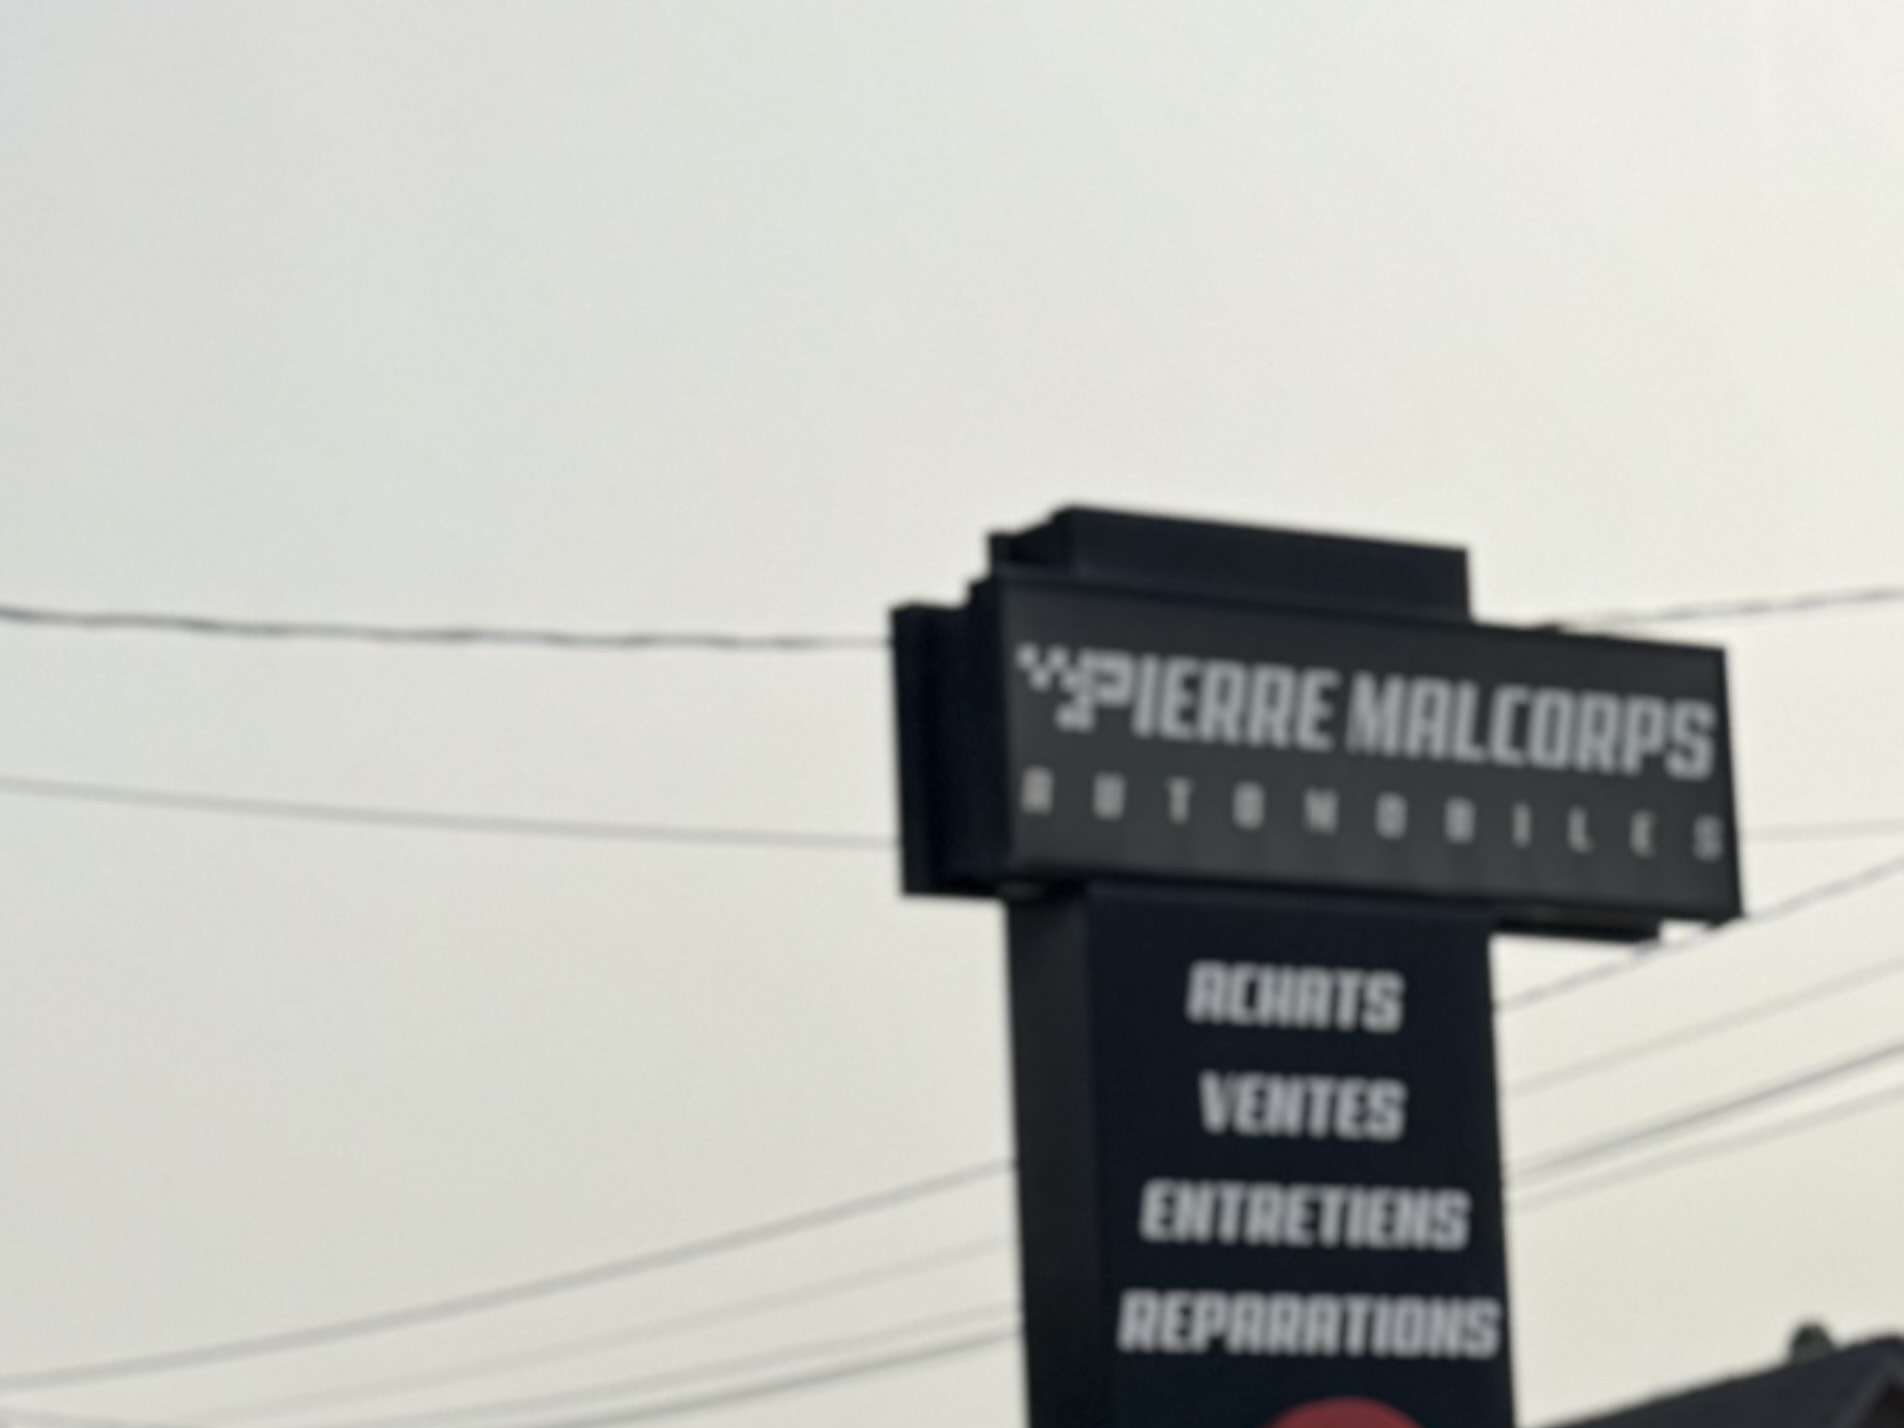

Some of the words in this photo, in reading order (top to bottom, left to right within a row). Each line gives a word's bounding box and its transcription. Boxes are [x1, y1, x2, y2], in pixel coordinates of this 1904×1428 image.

[1055, 646, 1342, 755] PIERRE
[1345, 670, 1716, 781] MALCORPS
[1019, 766, 1726, 862] AUTOMOBILES
[1185, 960, 1406, 1034] ACHATS
[1199, 1069, 1409, 1142] VENTES
[1138, 1177, 1472, 1252] ENTRETIENS
[1115, 1288, 1503, 1361] REPARATIONS
